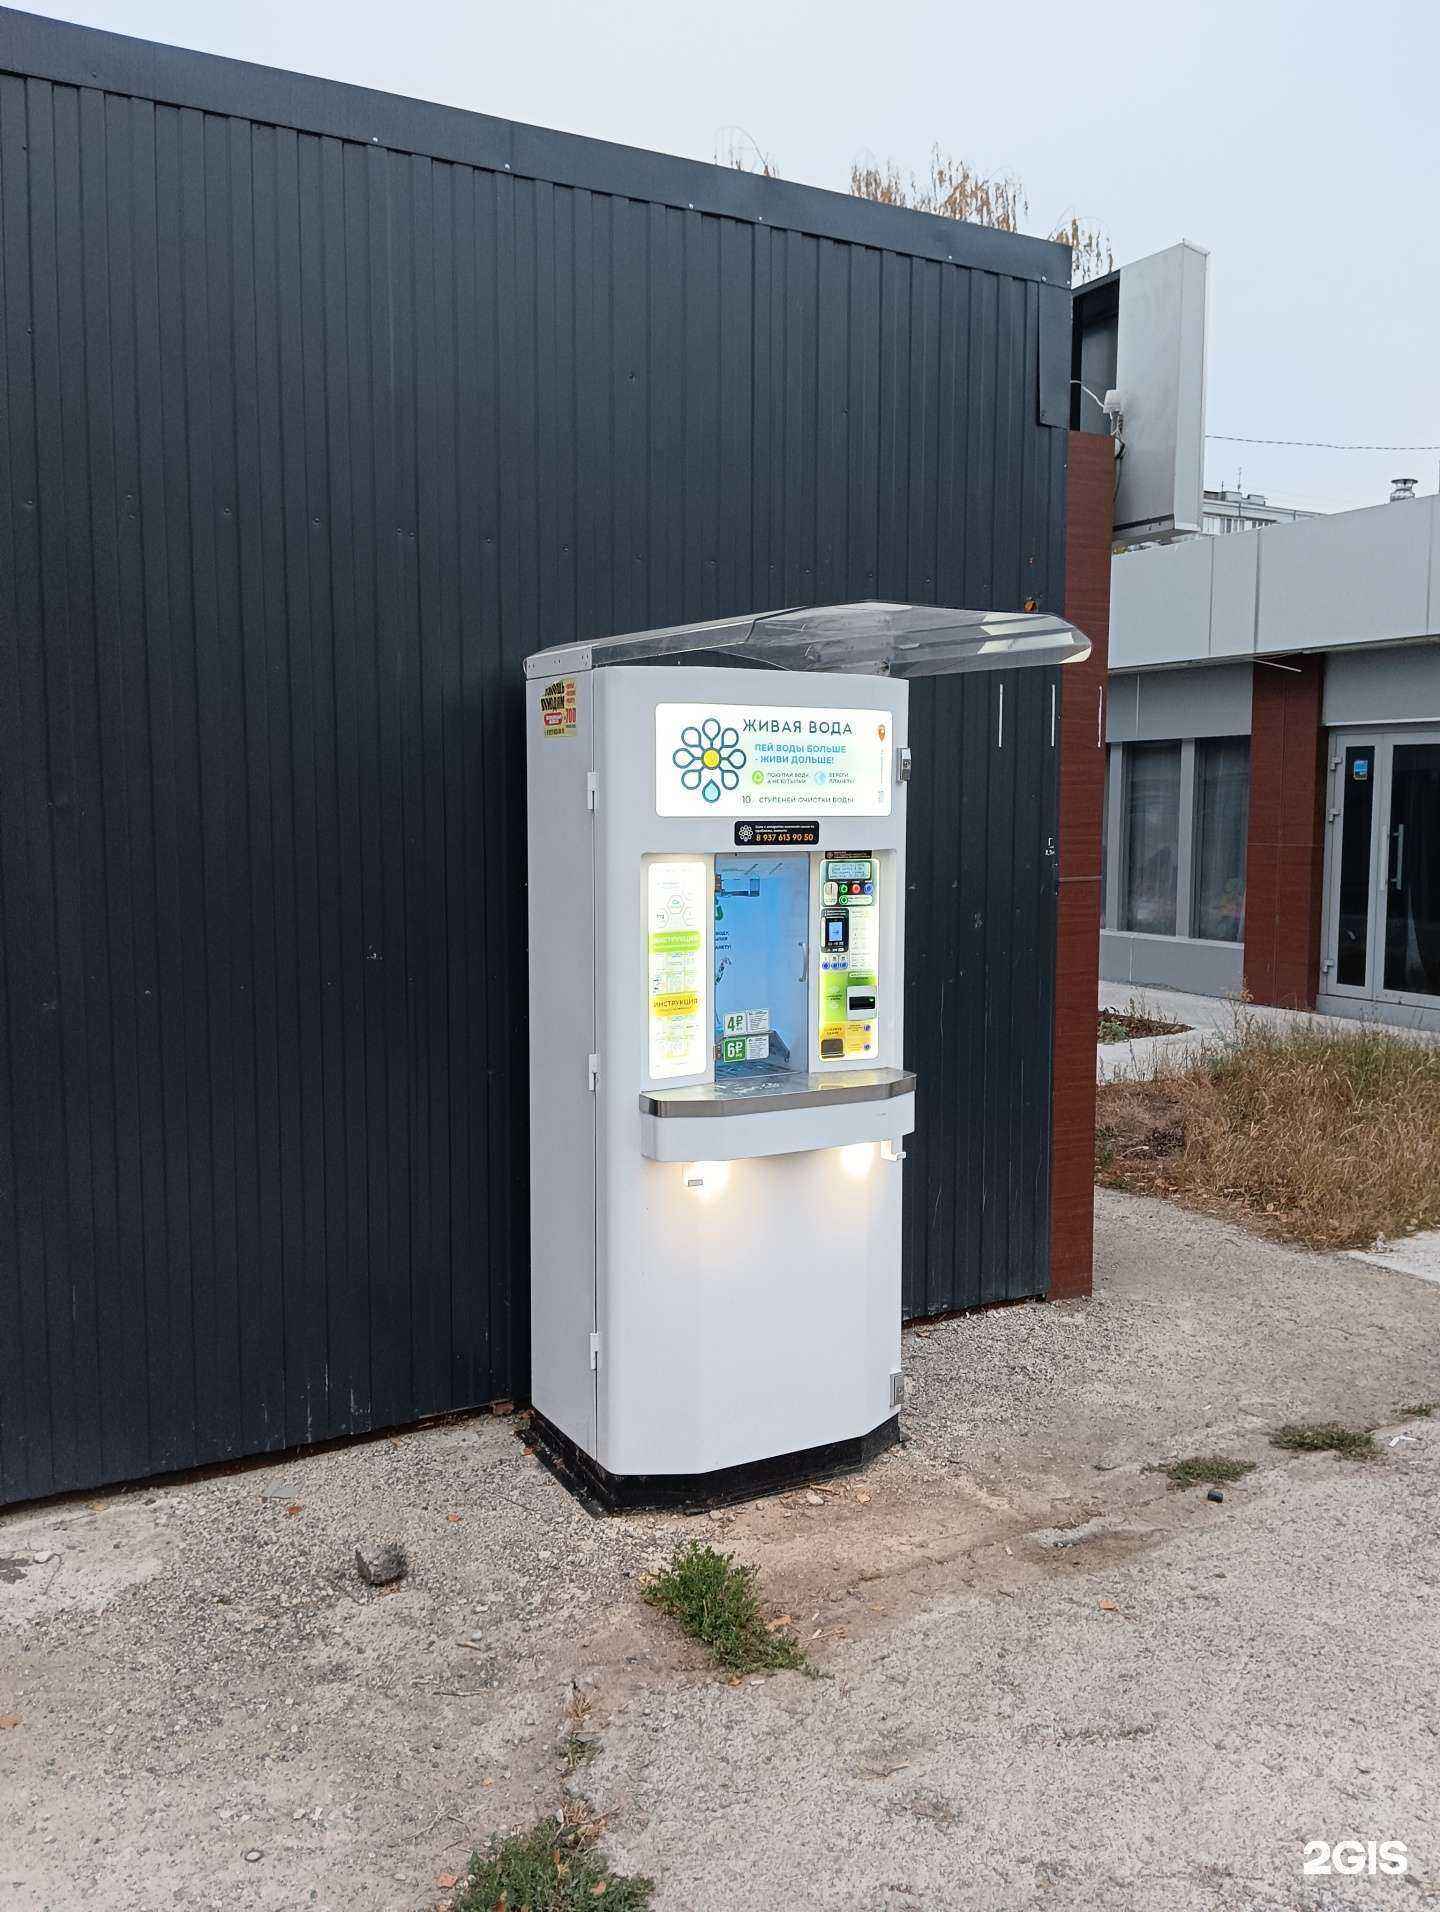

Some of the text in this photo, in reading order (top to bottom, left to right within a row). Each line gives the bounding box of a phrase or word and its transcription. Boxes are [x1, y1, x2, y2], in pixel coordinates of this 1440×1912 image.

[743, 719, 852, 736] ЖИВАЯ ВОДА
[755, 743, 847, 753] ПЕЙ ВОДЫ БОЛЬШЕ
[761, 755, 789, 763] ЖИВИ
[791, 756, 834, 765] ДОЛЬШЕ!
[742, 795, 751, 804] 10
[654, 998, 698, 1008] ИНСТРУКЦИЯ
